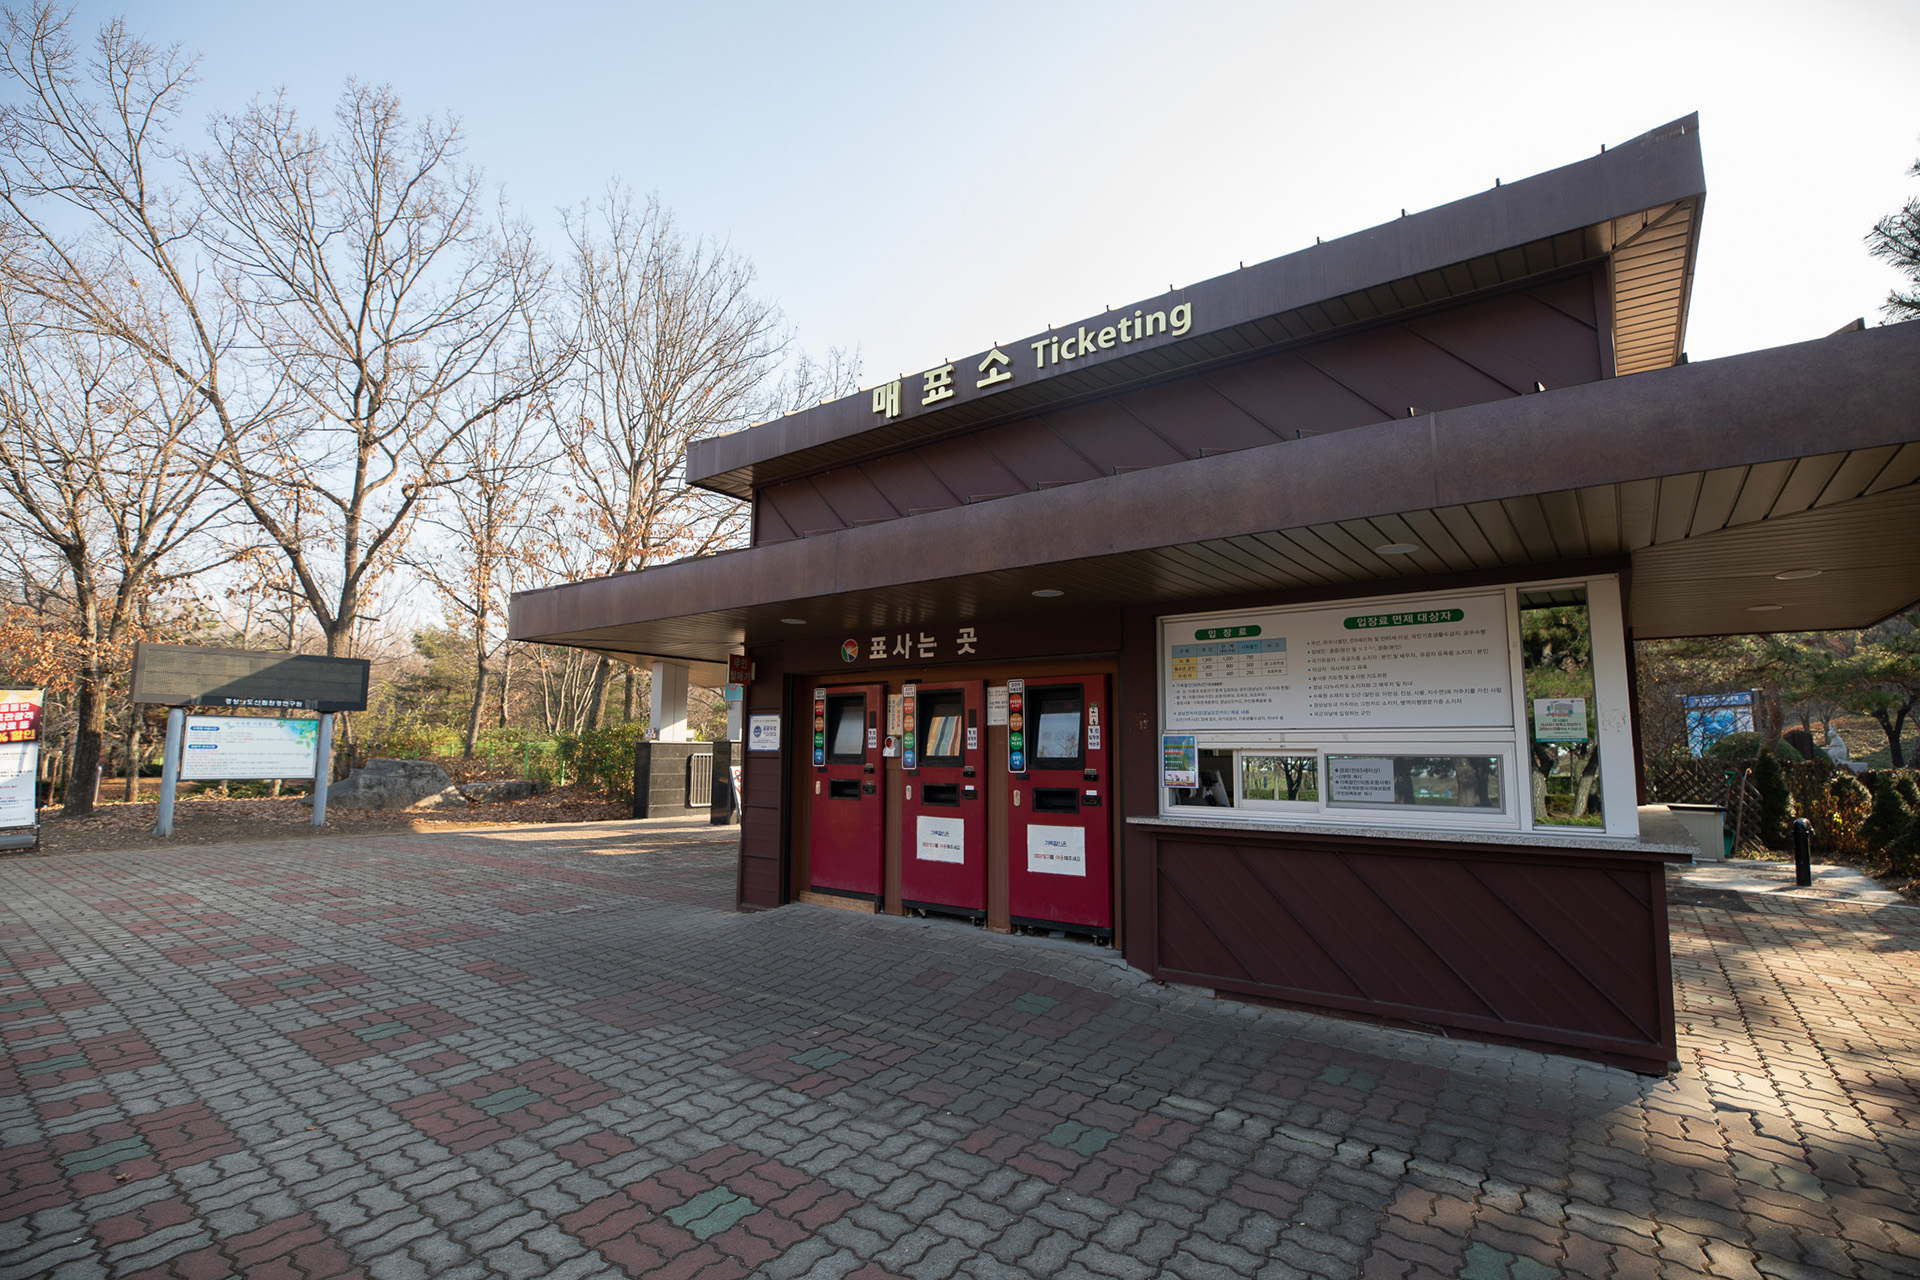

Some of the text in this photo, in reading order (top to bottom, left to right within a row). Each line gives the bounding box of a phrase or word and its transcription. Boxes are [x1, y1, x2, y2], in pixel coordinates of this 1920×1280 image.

[1031, 302, 1192, 368] Ticketing
[1357, 610, 1451, 628] 입장료 면제 대상자
[869, 627, 977, 660] 표사는 곳
[11, 729, 36, 741] 할인
